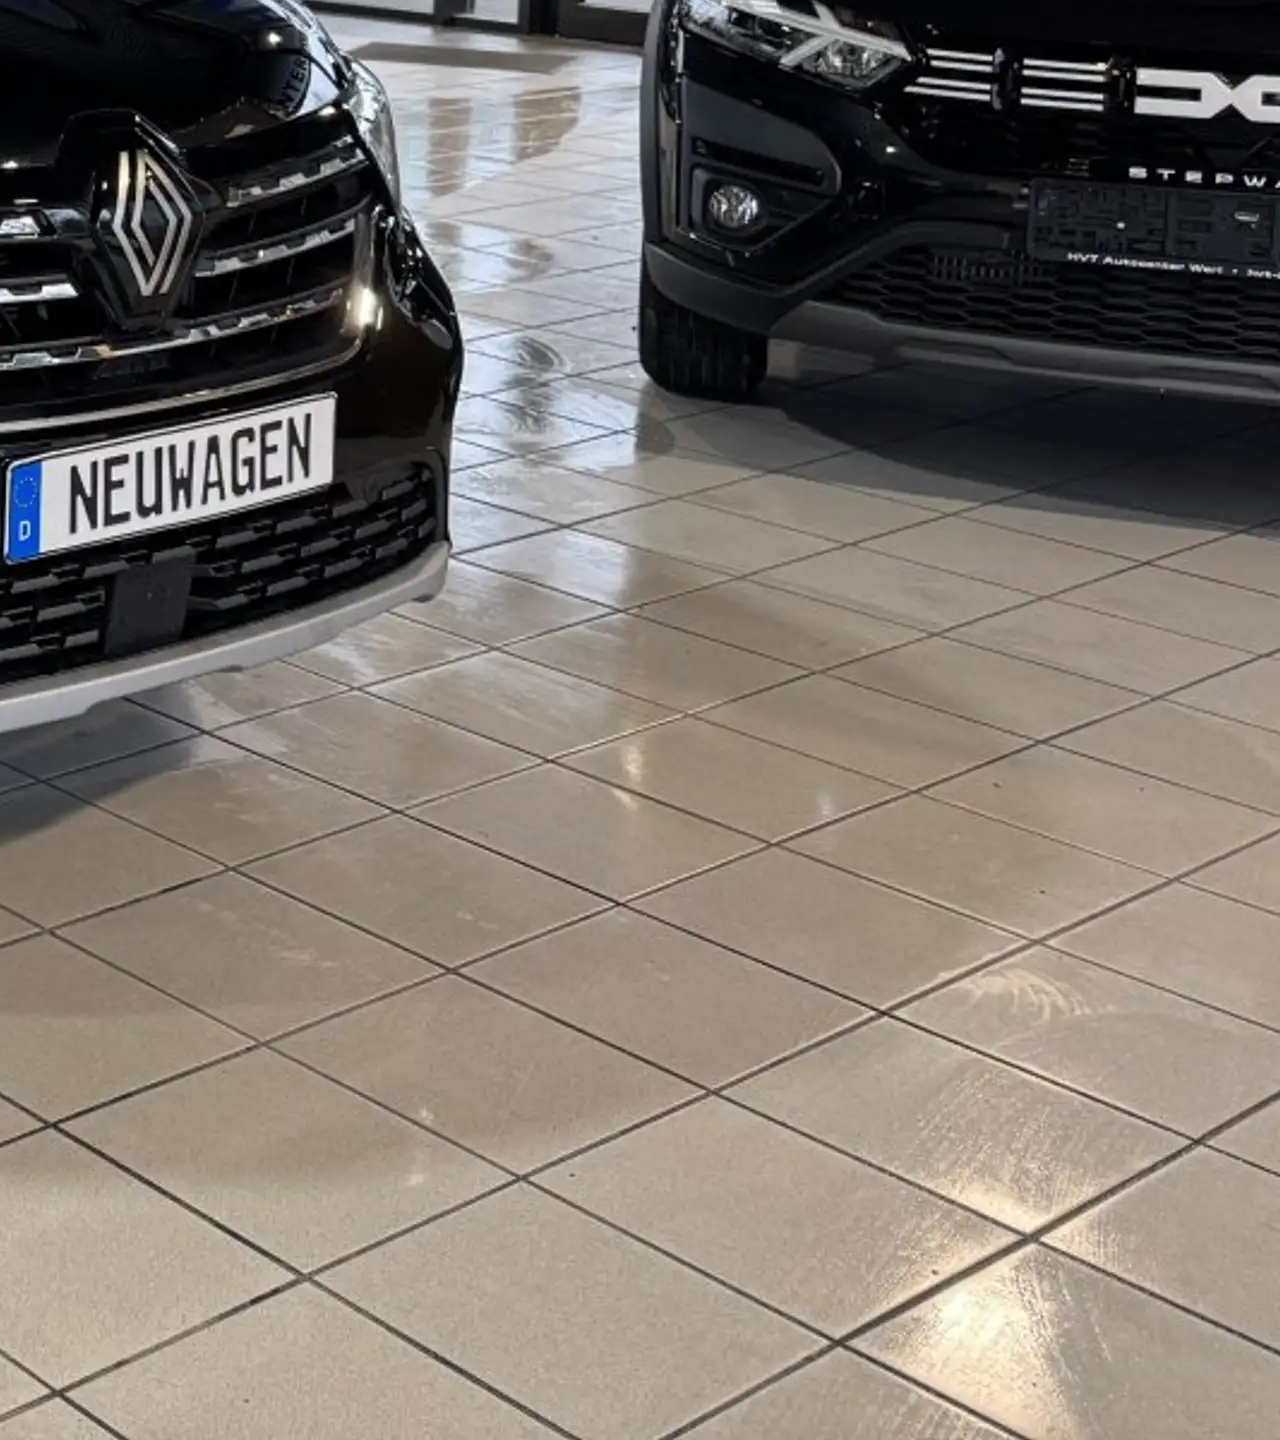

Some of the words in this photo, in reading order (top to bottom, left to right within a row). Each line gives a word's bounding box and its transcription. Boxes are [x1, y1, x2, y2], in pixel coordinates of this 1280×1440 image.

[1128, 165, 1280, 189] STEPW
[69, 413, 312, 535] NEUWAGEN
[18, 520, 32, 542] D
